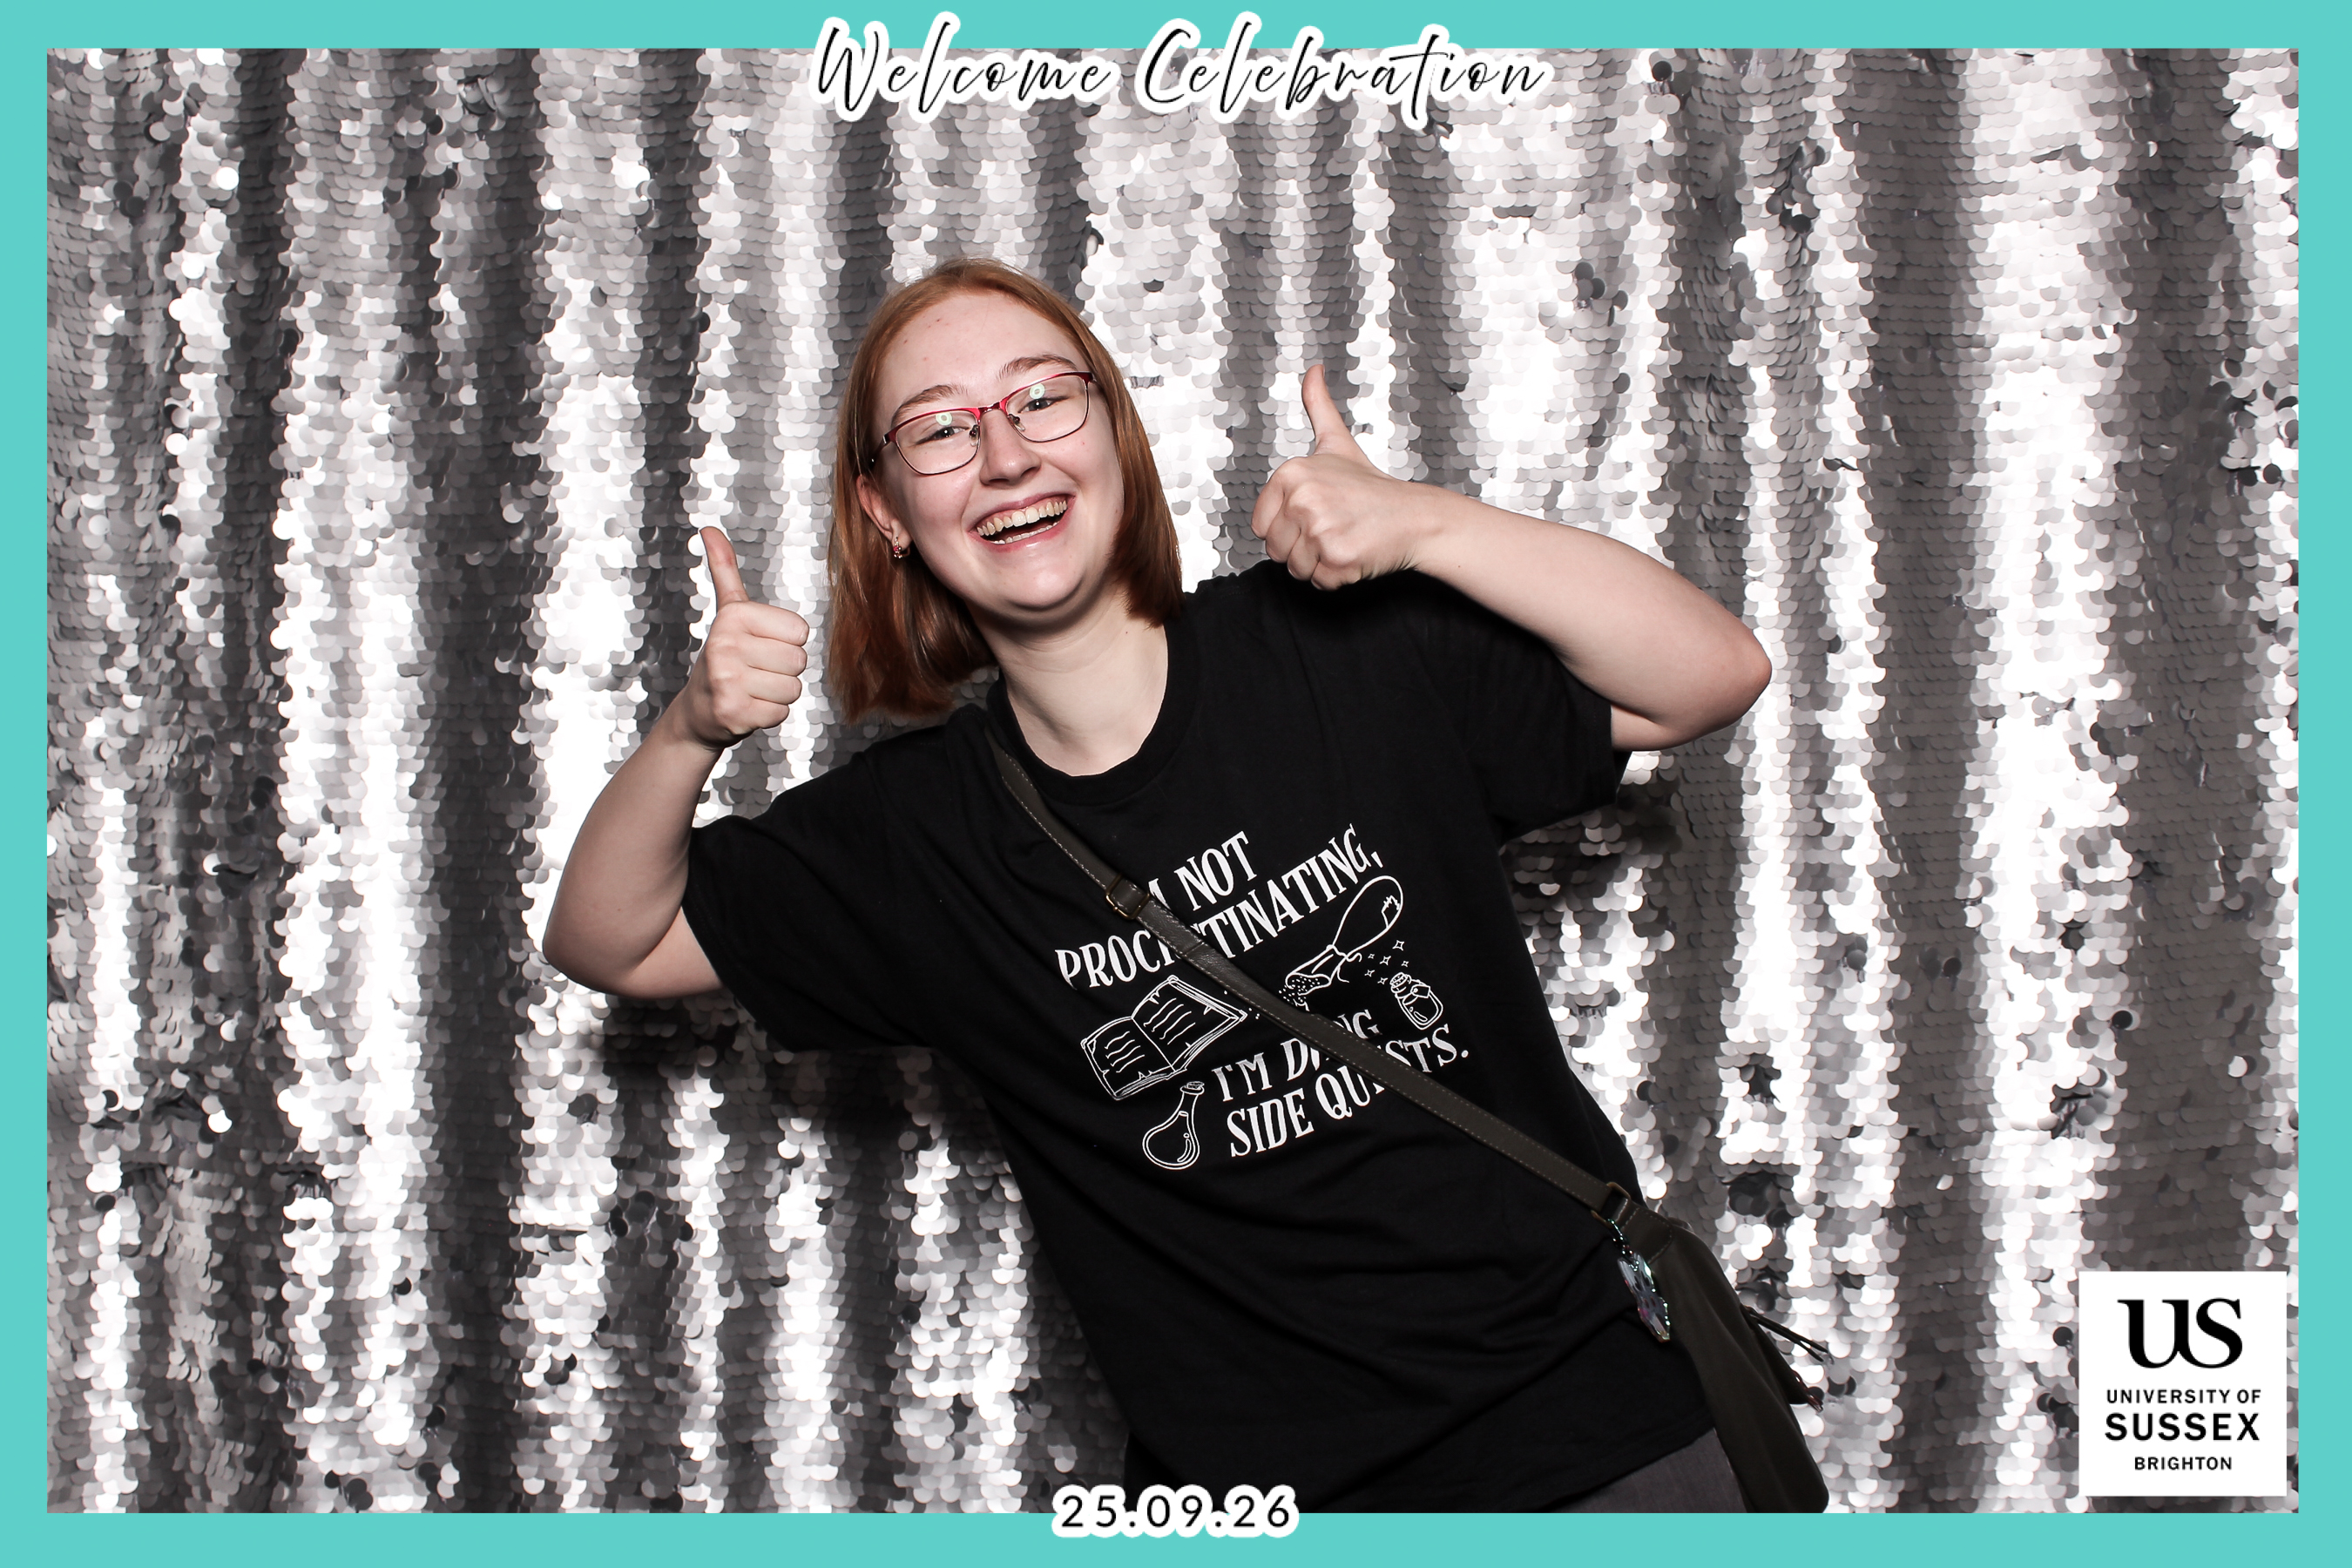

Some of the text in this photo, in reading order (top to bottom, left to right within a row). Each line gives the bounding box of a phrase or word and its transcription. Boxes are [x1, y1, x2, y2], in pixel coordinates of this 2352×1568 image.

[1054, 822, 1384, 989] PROCTINATING,
[1173, 830, 1258, 911] NOT
[1211, 1051, 1273, 1102] I'M
[1227, 1088, 1315, 1158] SIDE
[1315, 1024, 1470, 1121] QUSTS.
